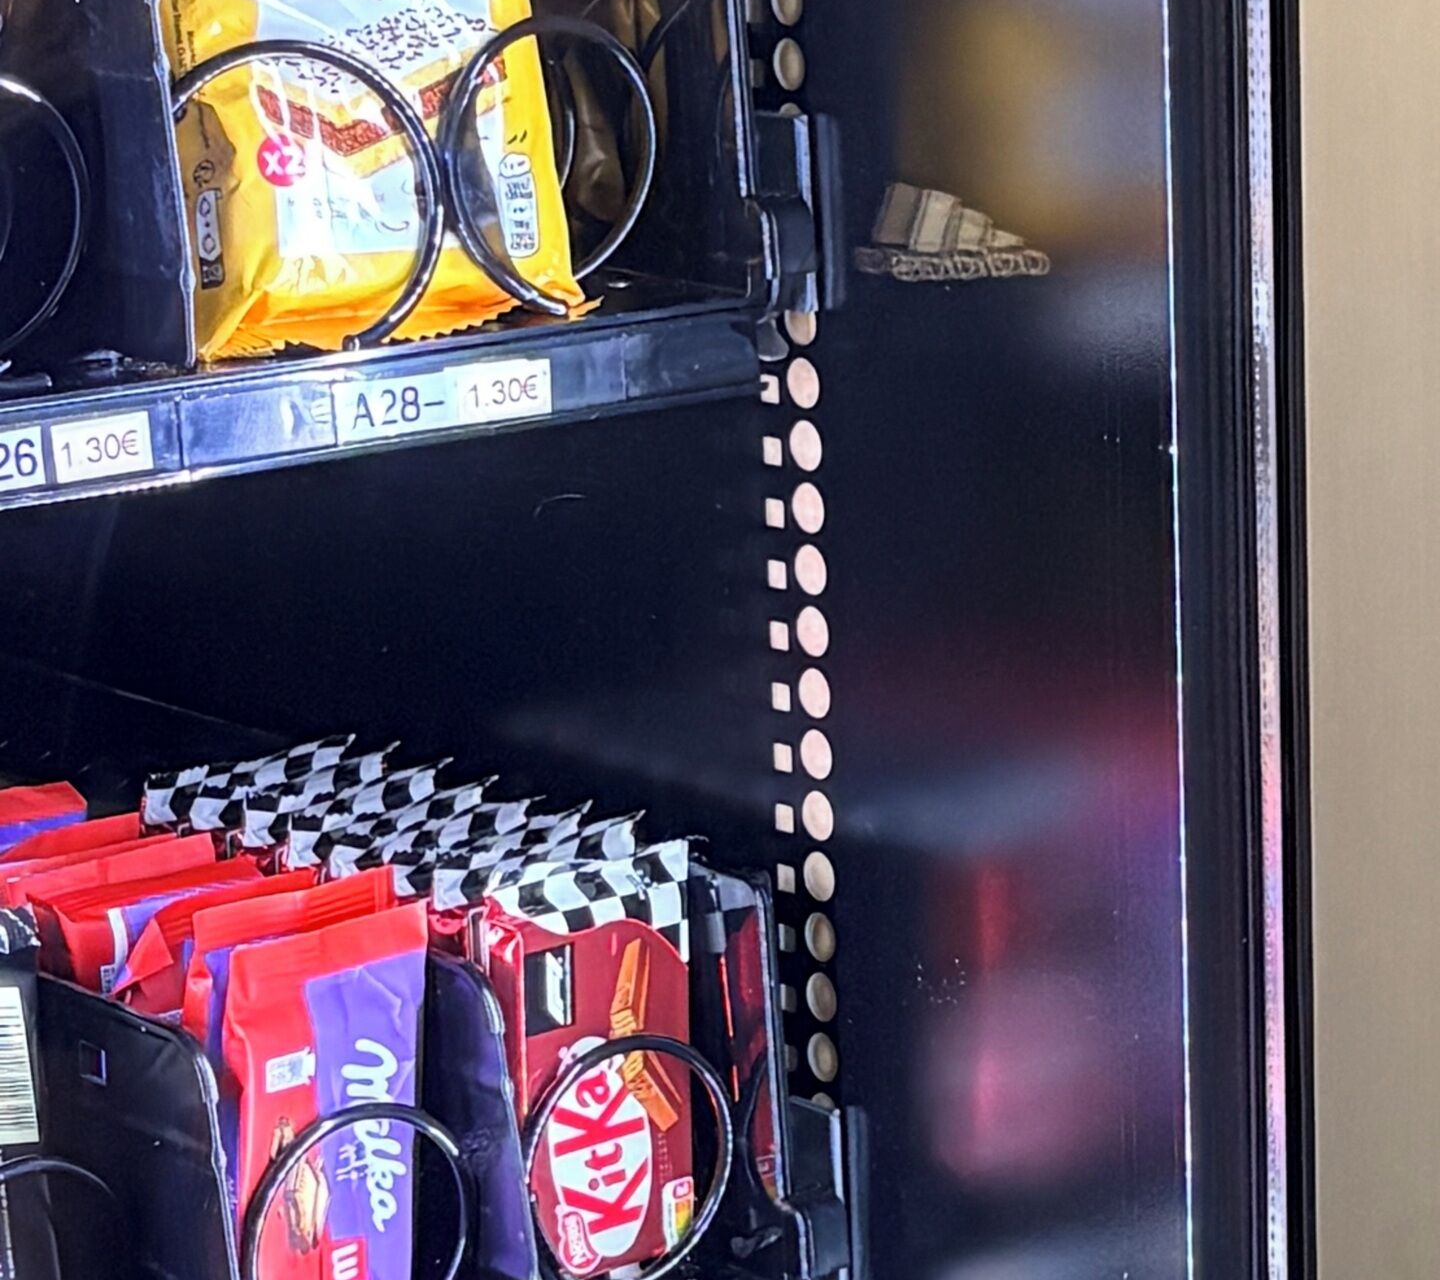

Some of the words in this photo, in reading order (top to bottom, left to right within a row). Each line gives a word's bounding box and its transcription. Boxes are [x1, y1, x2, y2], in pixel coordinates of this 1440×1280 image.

[467, 372, 539, 410] 1.30€
[61, 429, 140, 469] 1.30€
[552, 1069, 649, 1235] KitKa
